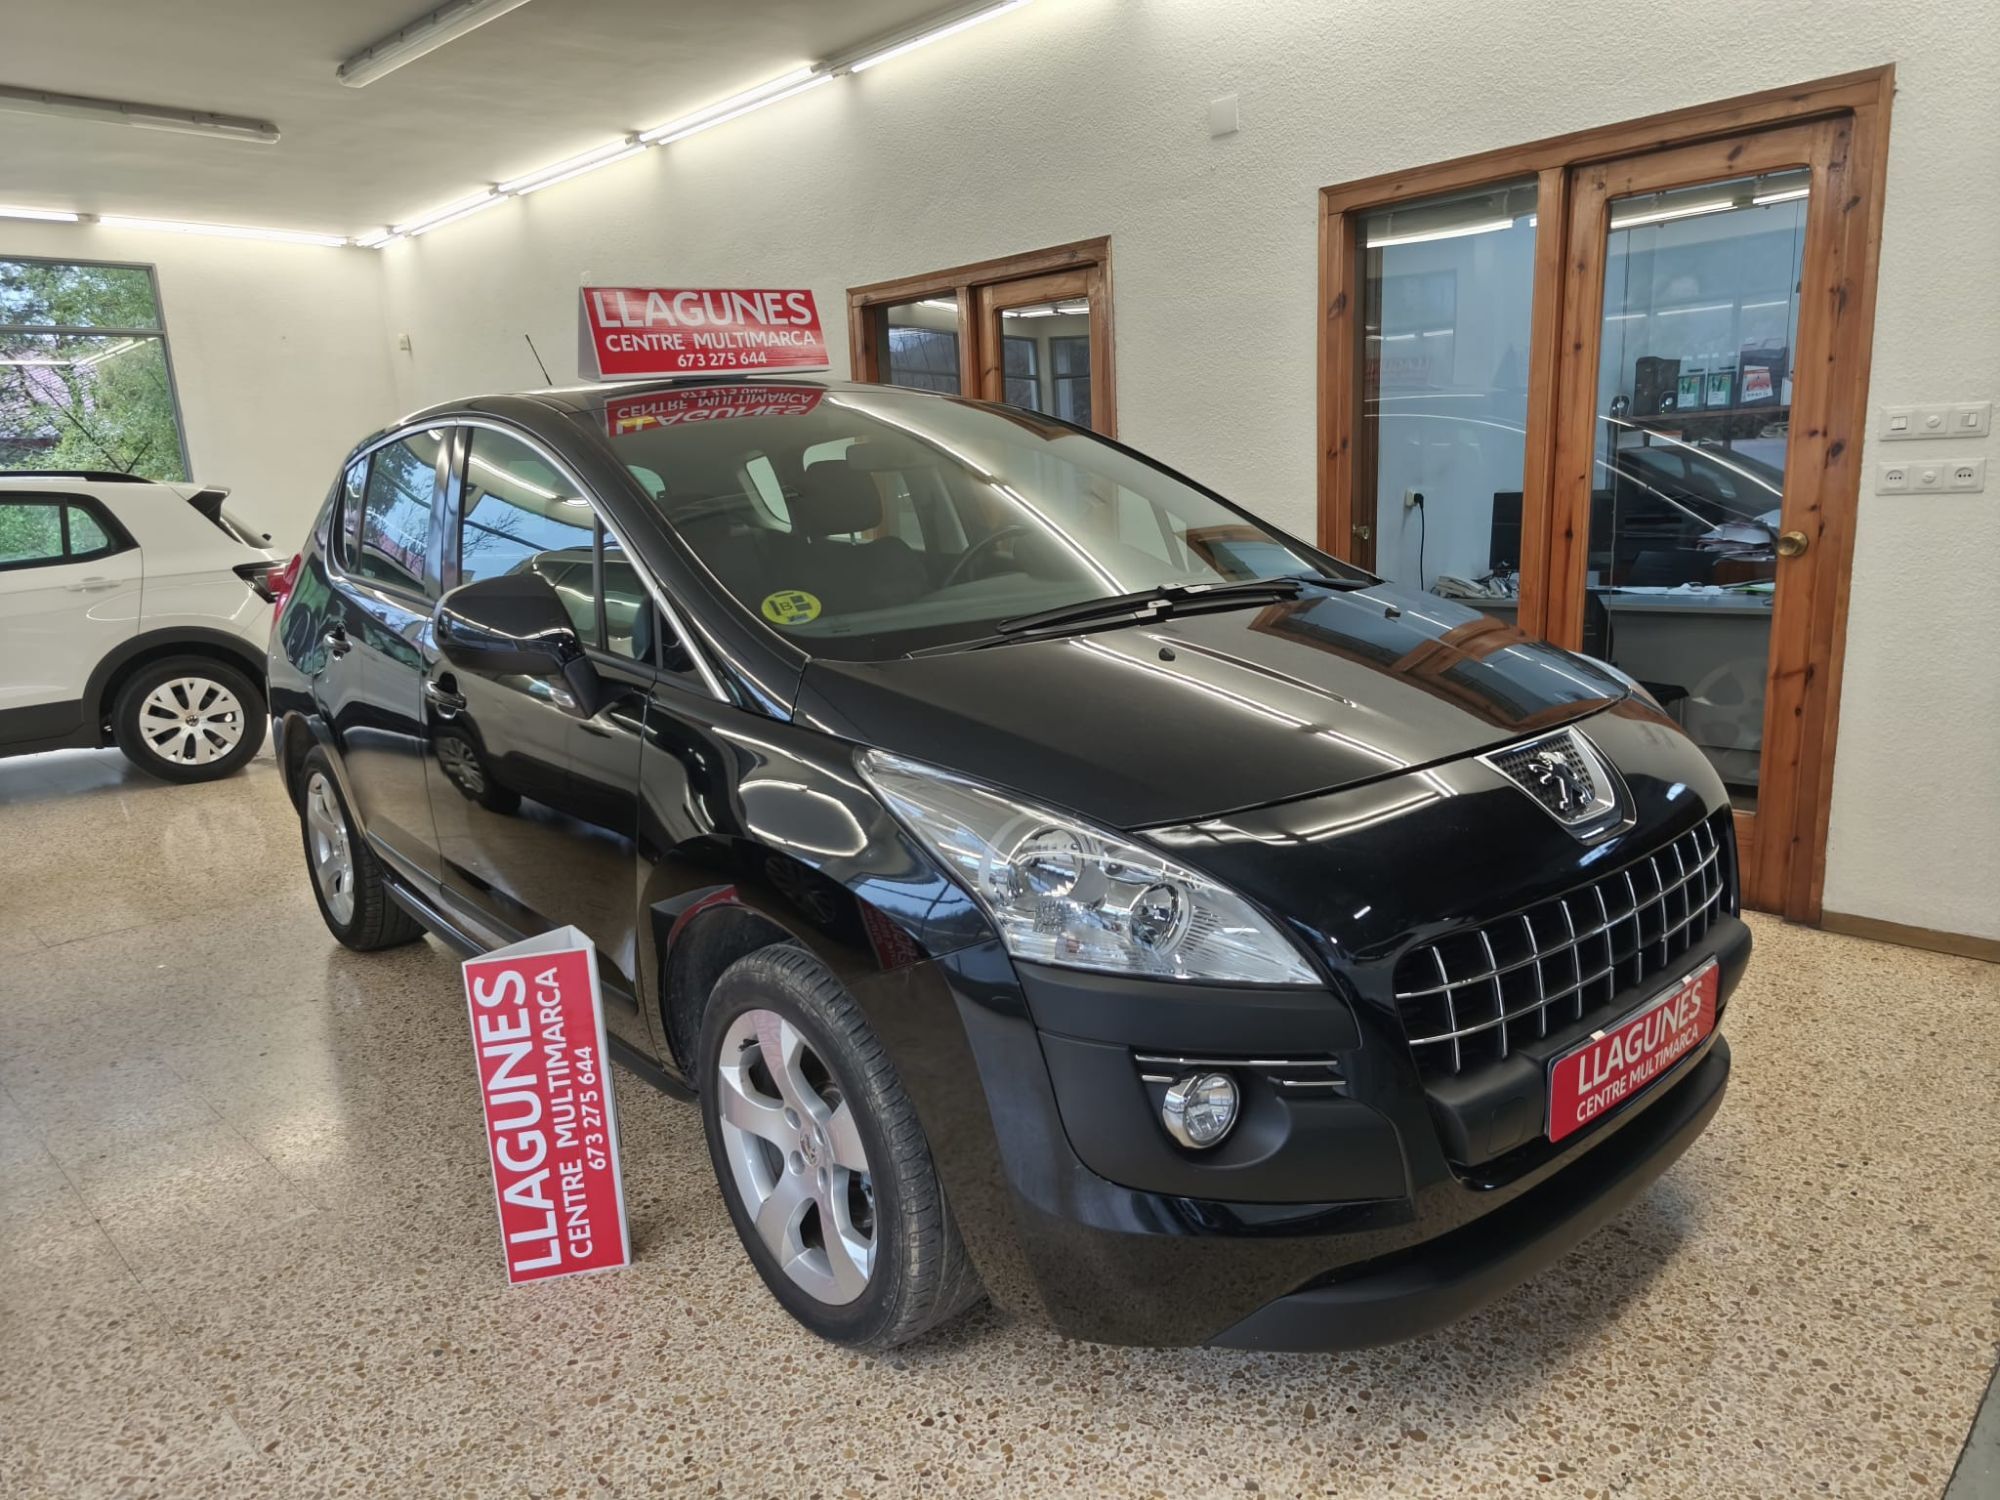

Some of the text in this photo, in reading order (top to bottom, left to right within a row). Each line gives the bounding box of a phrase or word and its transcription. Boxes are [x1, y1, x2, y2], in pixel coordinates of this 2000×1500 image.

[592, 291, 812, 328] LLAGUNES
[605, 330, 816, 352] CENTRE MULTIMARCA
[677, 351, 767, 367] 673 275 644
[1576, 1023, 1699, 1122] CENTRE MULTIMARCA
[1578, 981, 1702, 1095] LLAGUNES
[473, 969, 562, 1273] LLAGUNES
[535, 966, 593, 1259] CENTRE MULTIMARCA
[574, 1046, 607, 1171] 673 275 644
